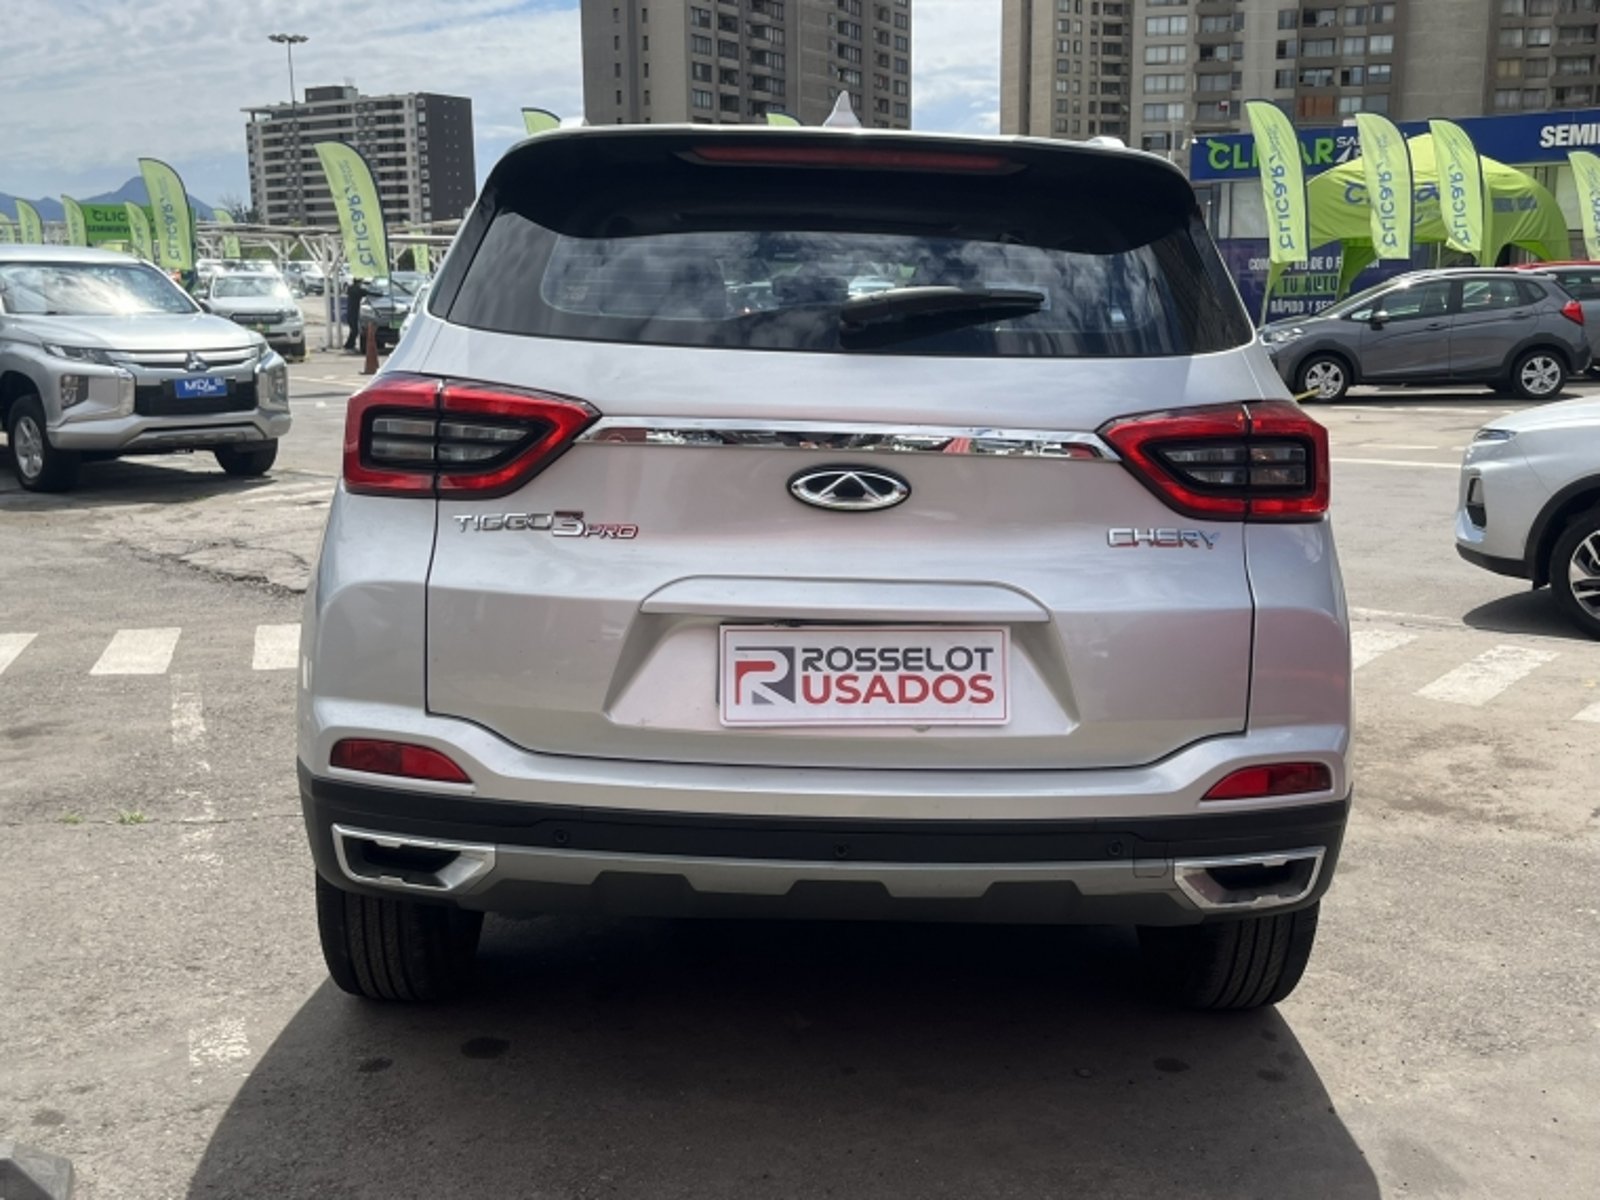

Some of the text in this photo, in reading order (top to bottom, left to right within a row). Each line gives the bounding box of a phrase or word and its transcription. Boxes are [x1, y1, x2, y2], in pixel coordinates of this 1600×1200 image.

[1540, 124, 1600, 148] SEMI
[1206, 138, 1335, 169] CLIR
[1283, 277, 1298, 293] TU
[1107, 527, 1219, 550] CHERY
[801, 646, 995, 672] ROSSELOT
[801, 673, 996, 705] USADOS
